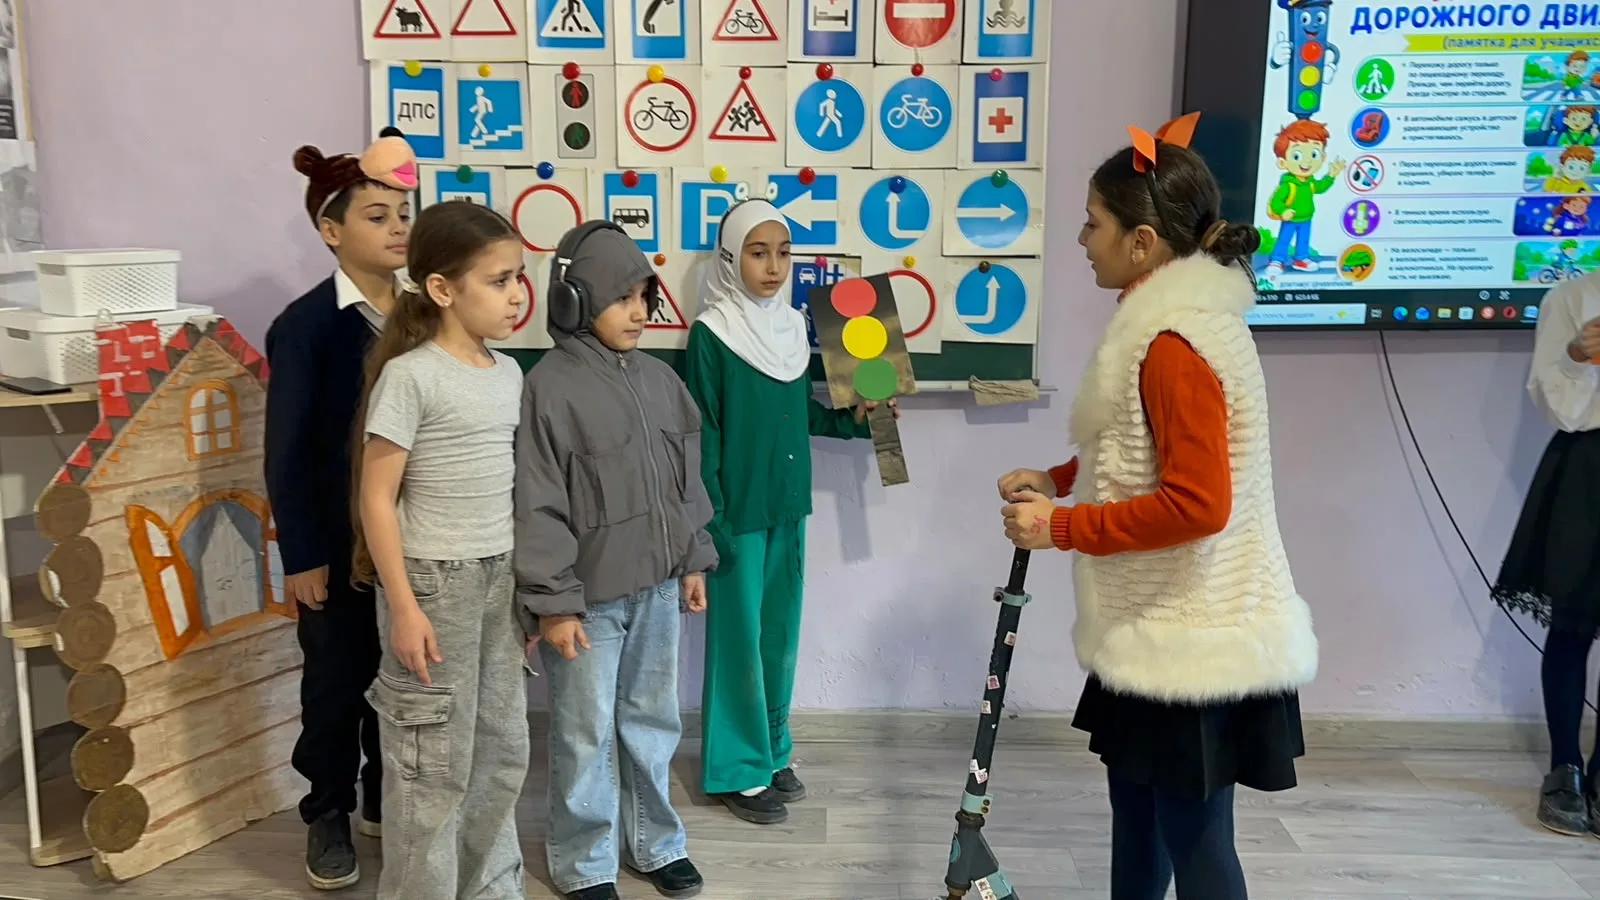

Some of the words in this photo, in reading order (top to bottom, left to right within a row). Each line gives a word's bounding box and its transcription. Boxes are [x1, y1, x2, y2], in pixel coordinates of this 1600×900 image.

[1350, 4, 1530, 34] ДОРОЖНОГО
[1539, 4, 1600, 30] ДВИ
[1443, 37, 1505, 50] (памятка
[1510, 36, 1536, 49] для
[398, 102, 435, 122] ДПС
